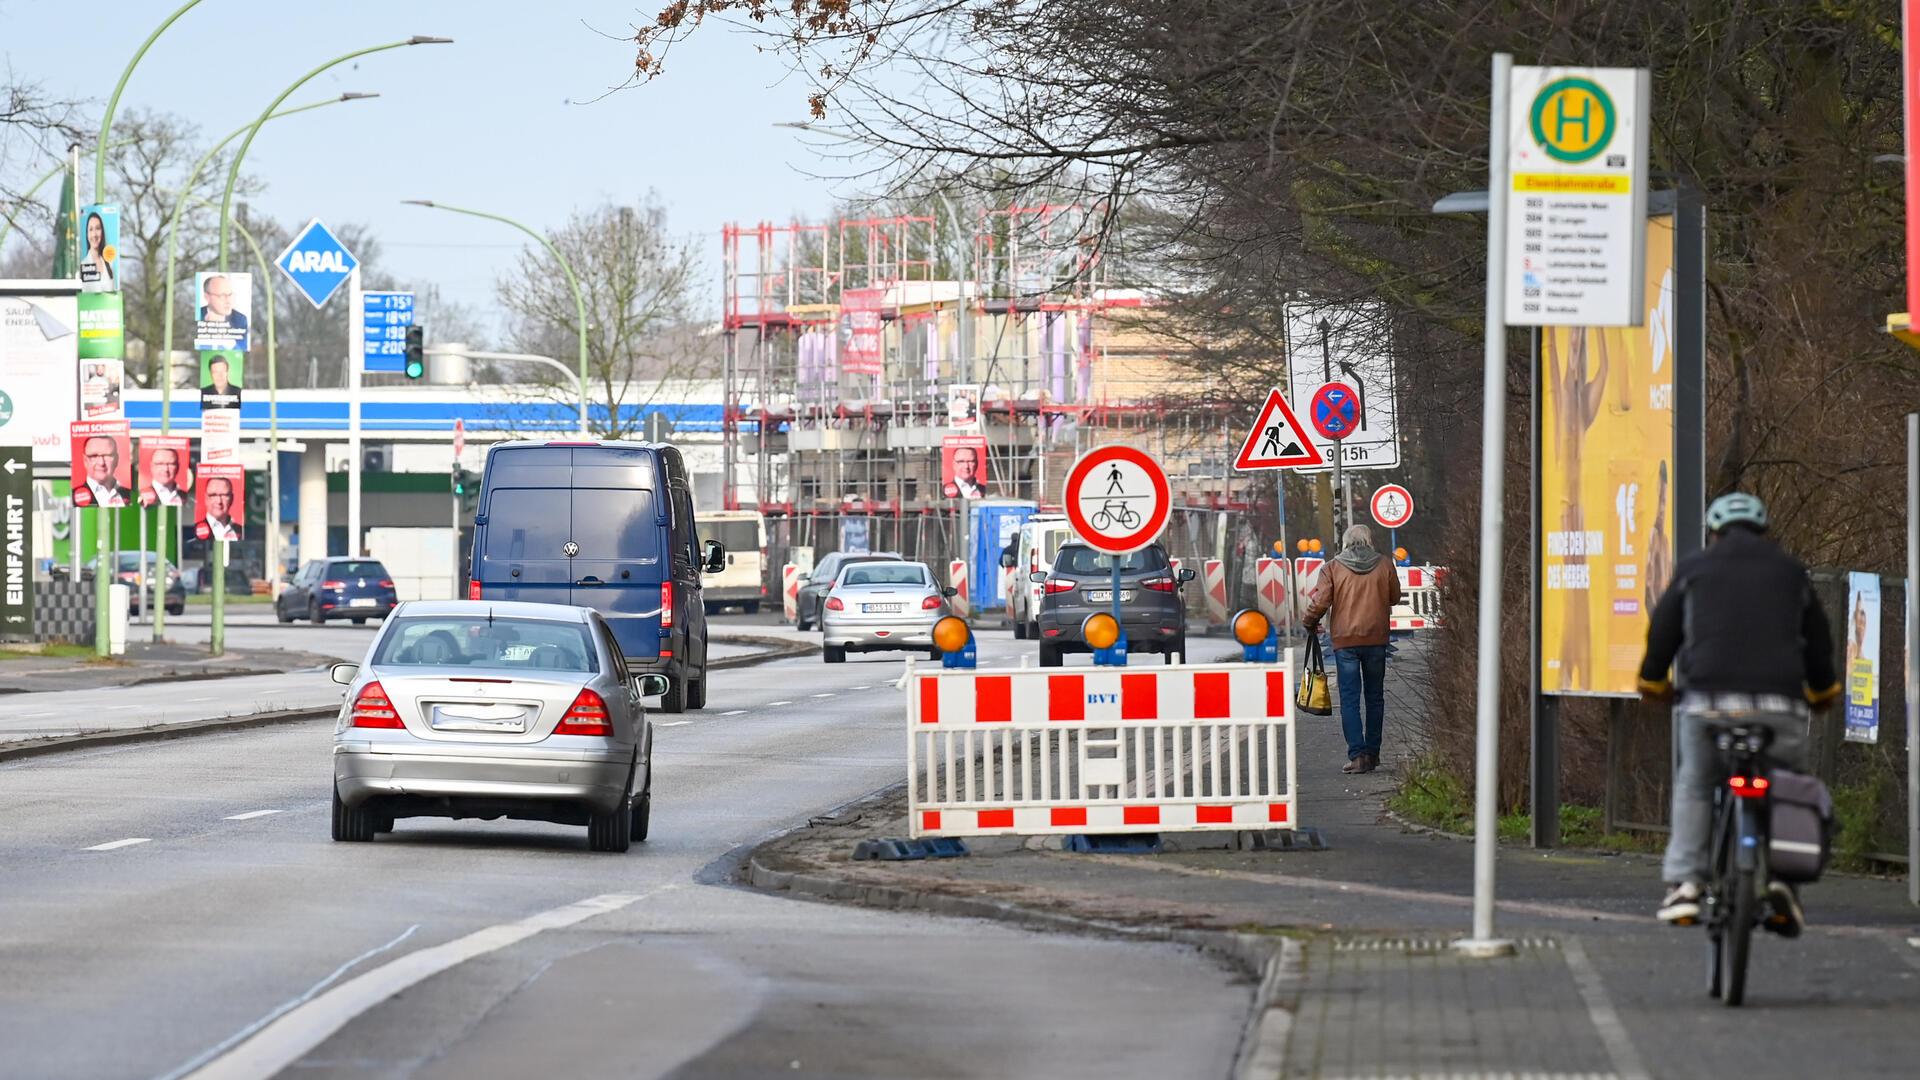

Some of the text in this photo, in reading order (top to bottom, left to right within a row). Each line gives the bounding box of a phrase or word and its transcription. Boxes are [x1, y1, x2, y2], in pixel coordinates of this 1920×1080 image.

[1556, 95, 1590, 143] H
[288, 250, 350, 273] ARAL
[71, 423, 127, 433] UWE SCHMIDT
[6, 494, 24, 606] EINFAHRT
[1088, 694, 1118, 704] BVT
